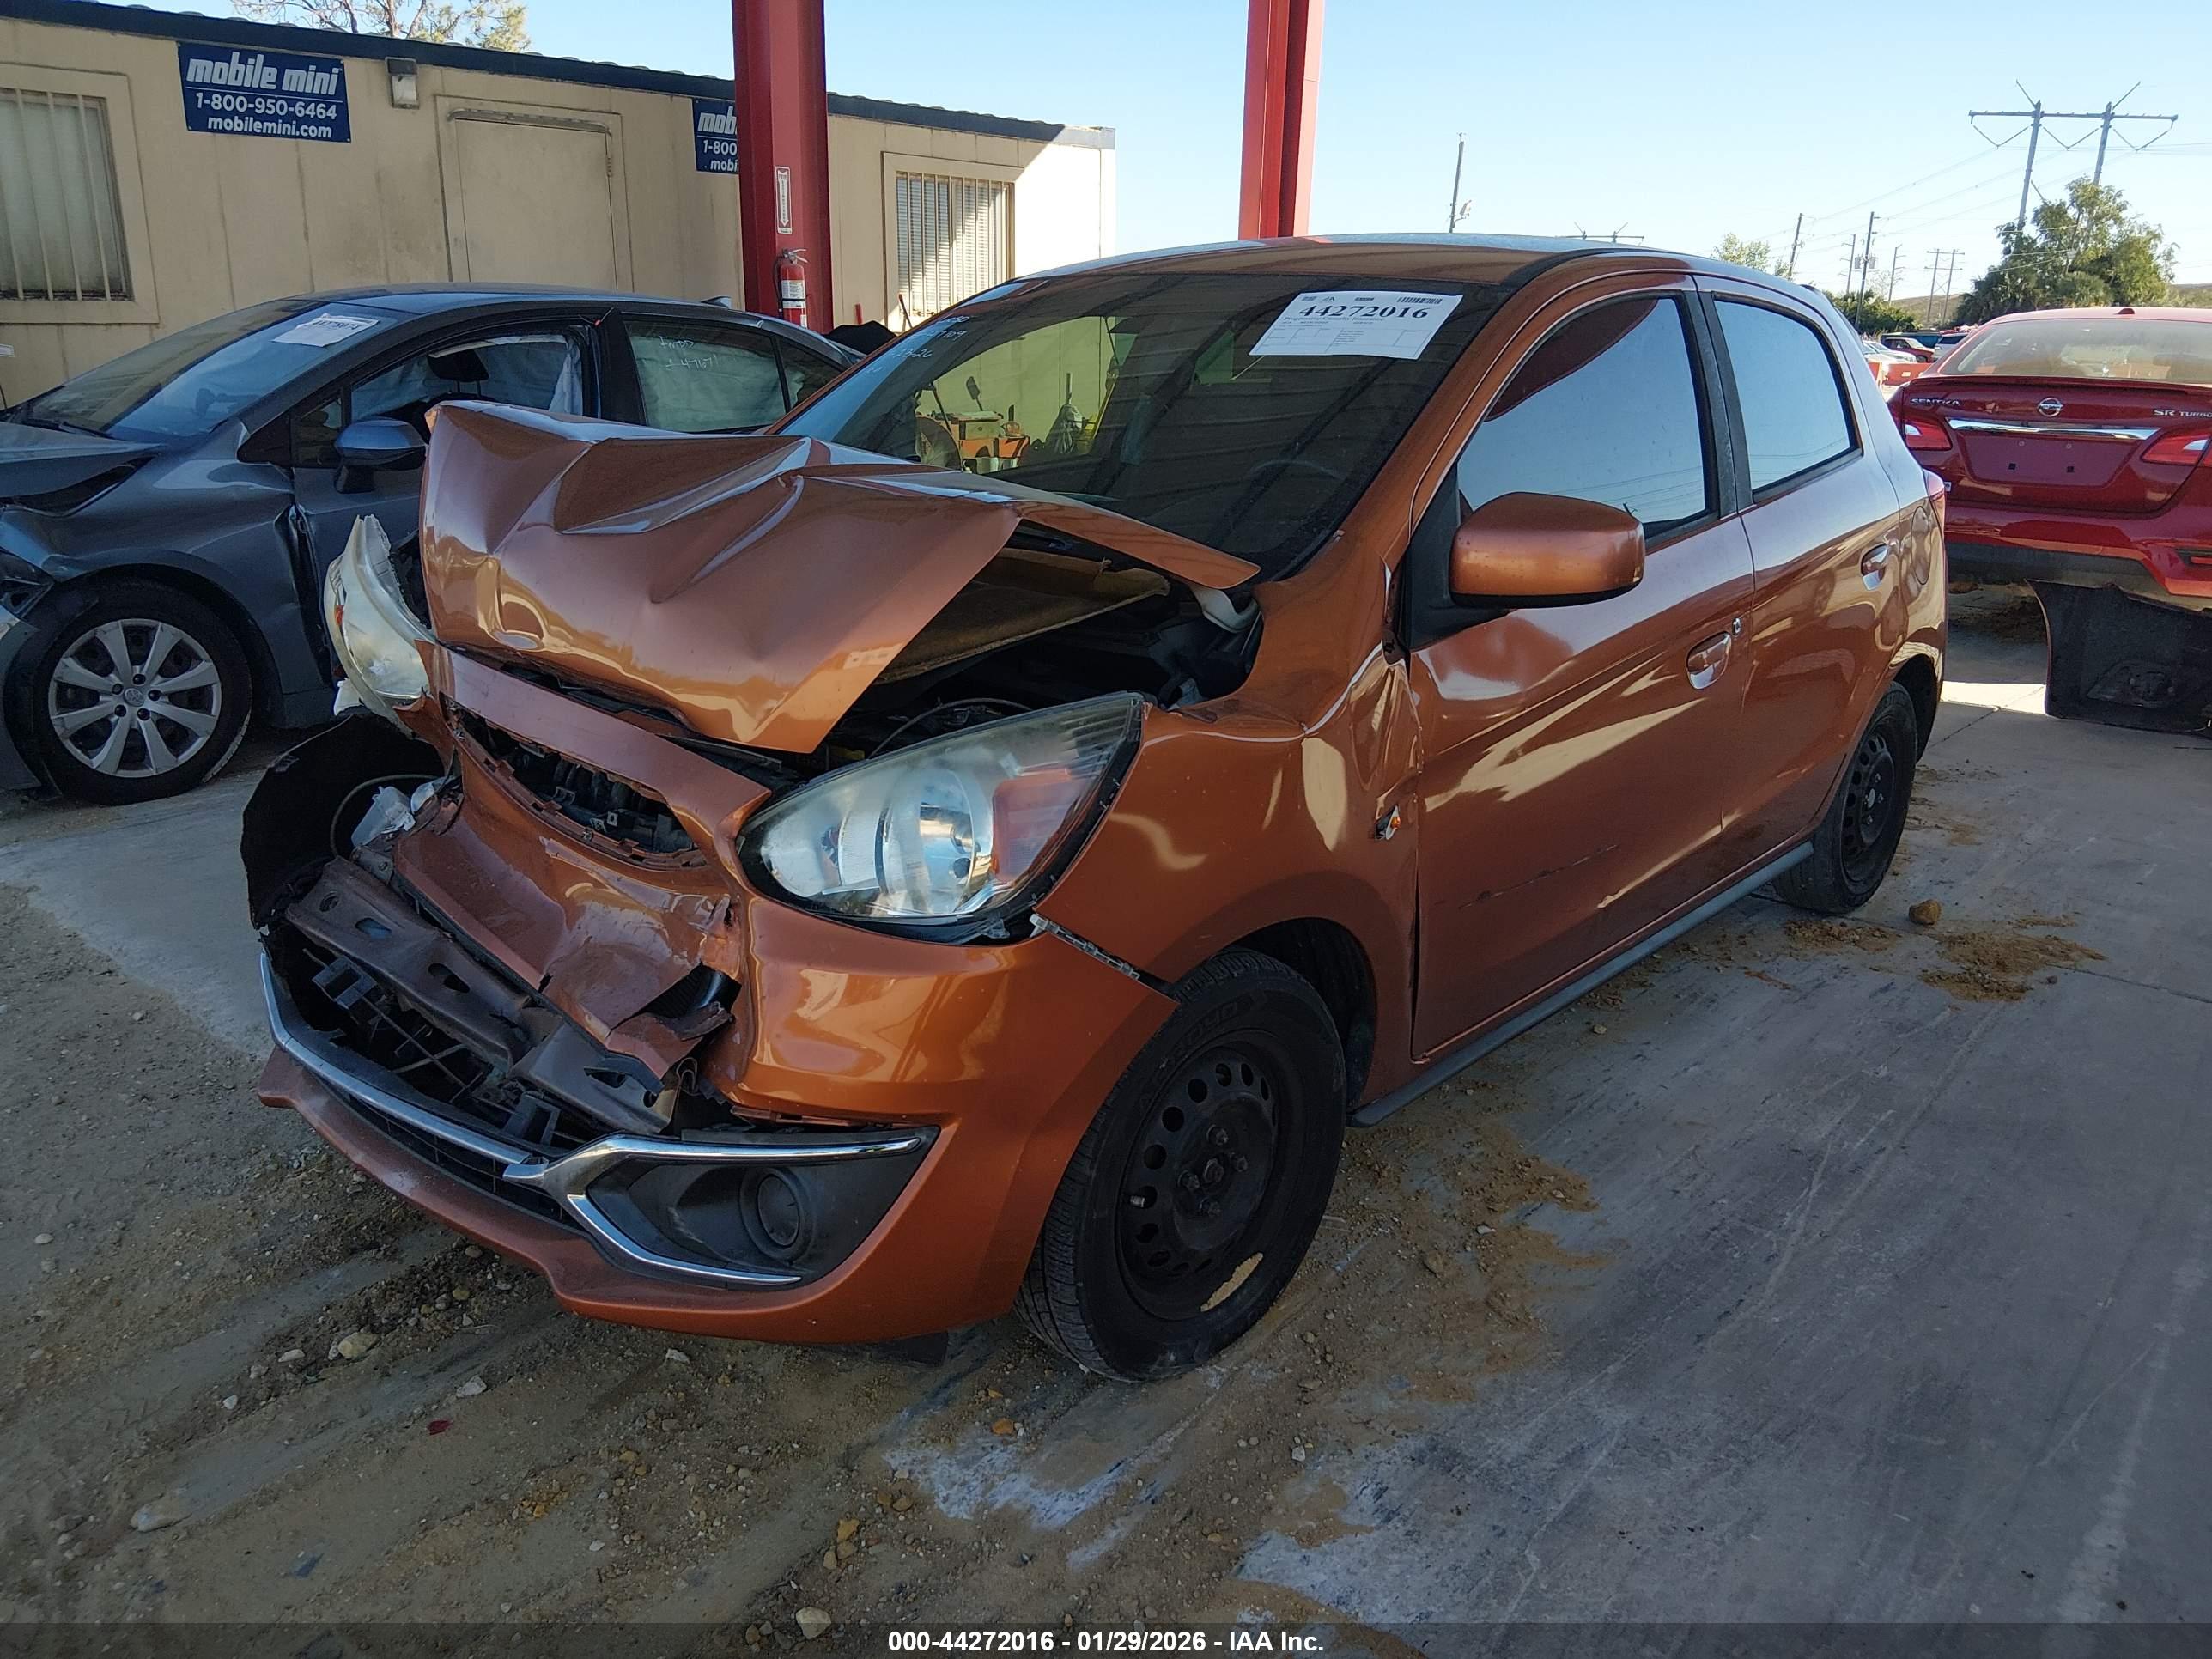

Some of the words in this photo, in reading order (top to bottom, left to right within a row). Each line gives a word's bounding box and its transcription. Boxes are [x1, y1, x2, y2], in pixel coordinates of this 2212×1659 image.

[186, 52, 278, 89] mobile
[282, 64, 340, 95] mini
[196, 92, 337, 119] 1-800-950-6464
[208, 115, 332, 138] mobilemini.com
[698, 106, 738, 135] mob
[710, 158, 738, 172] mobi
[1299, 305, 1432, 319] 44272016
